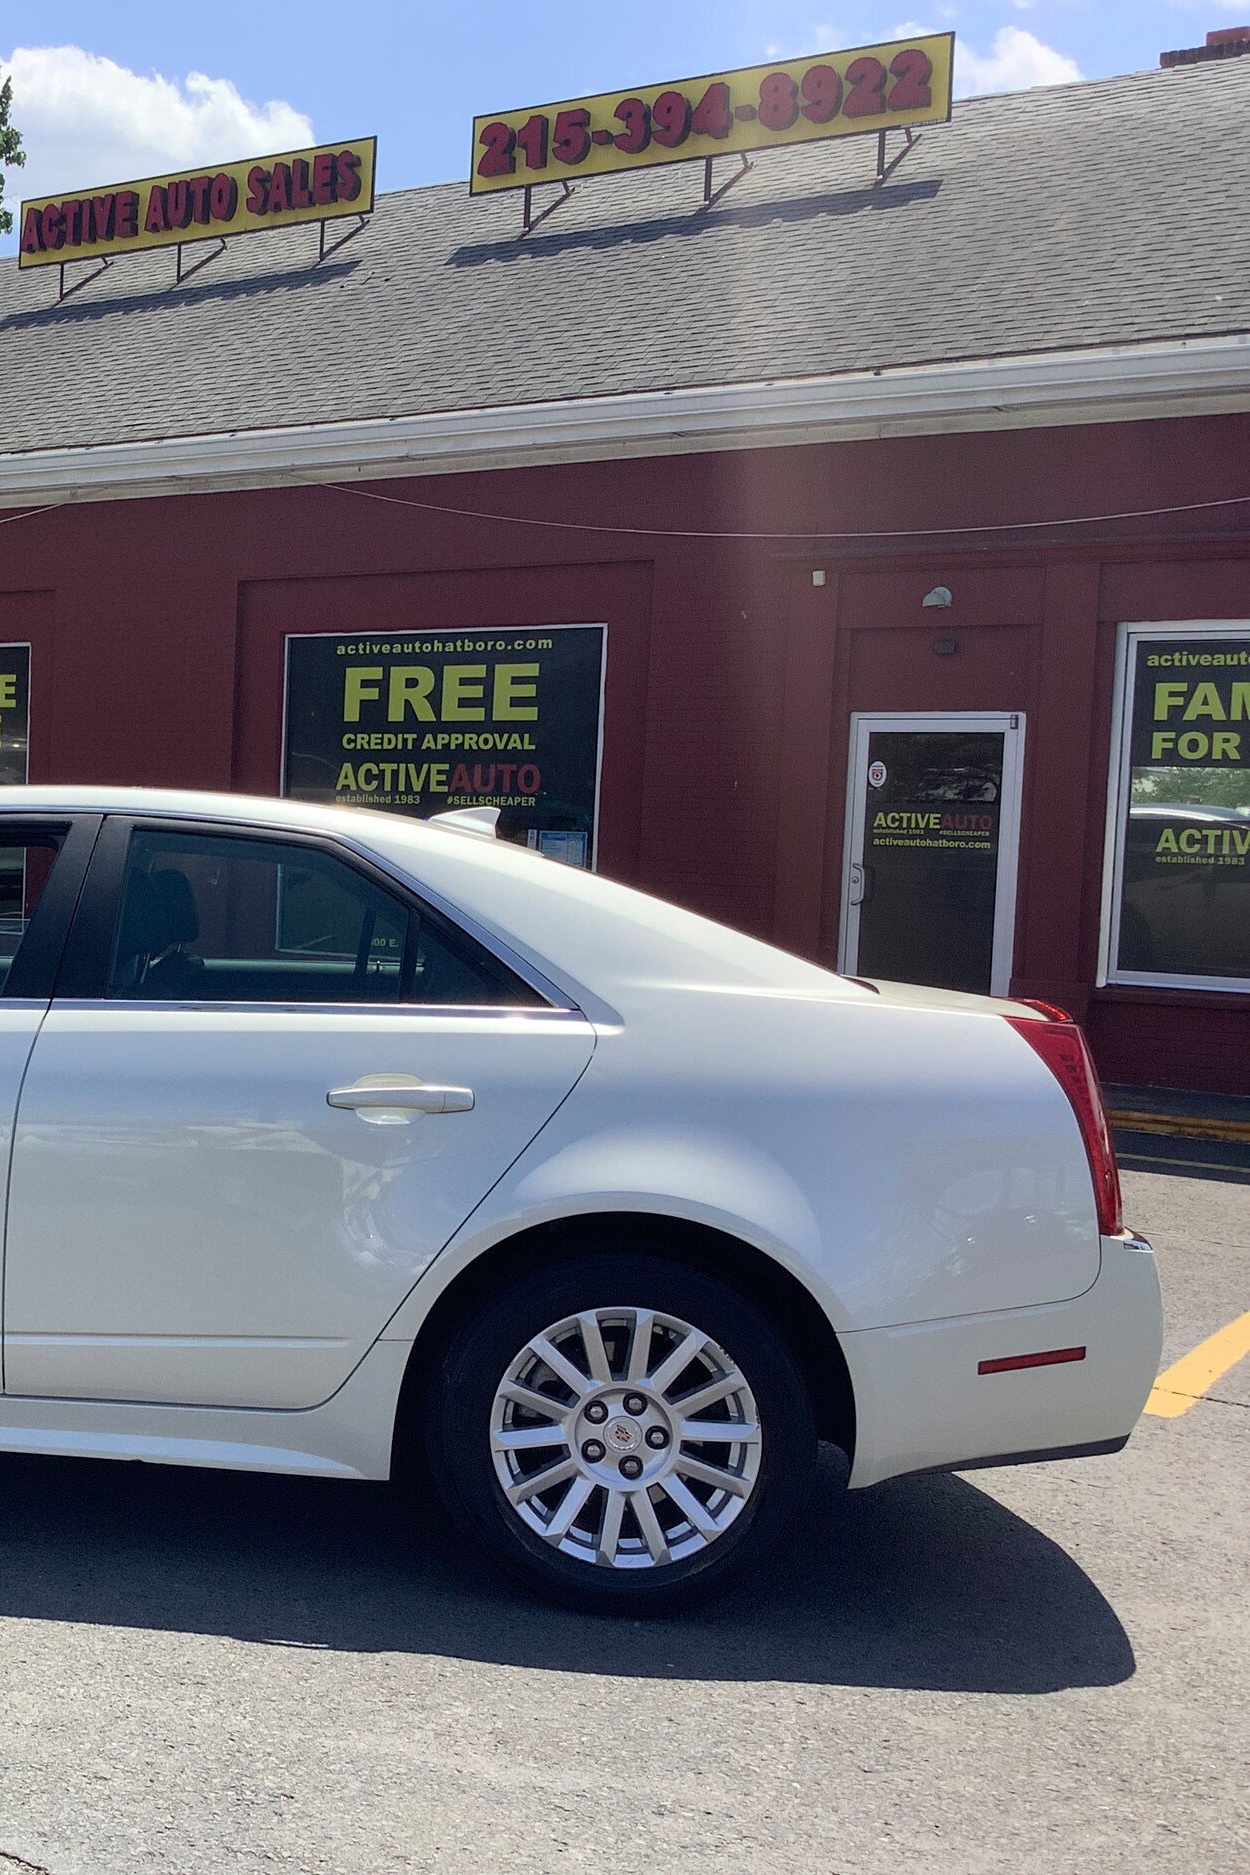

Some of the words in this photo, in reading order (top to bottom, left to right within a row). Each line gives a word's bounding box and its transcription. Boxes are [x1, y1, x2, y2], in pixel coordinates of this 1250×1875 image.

[477, 48, 933, 178] 215-394-8922
[21, 190, 140, 254] ACTIVE
[144, 172, 239, 233] AUTO
[246, 149, 363, 217] SALES
[336, 638, 553, 655] activeautohatboro.com
[1146, 651, 1250, 667] activeaut
[343, 663, 541, 722] FREE
[342, 733, 417, 750] CREDIT
[421, 733, 536, 750] APPROVAL
[1151, 731, 1241, 760] FOR
[335, 762, 542, 794] ACTIVEAUTO
[335, 793, 392, 805] established
[393, 795, 421, 805] 1983
[447, 795, 536, 807] #SELLSCHEAPER
[873, 811, 993, 830] ACTIVEAUTO
[873, 836, 991, 849] activeautohatboro.com
[1155, 855, 1215, 864] established
[1217, 856, 1245, 866] 1983
